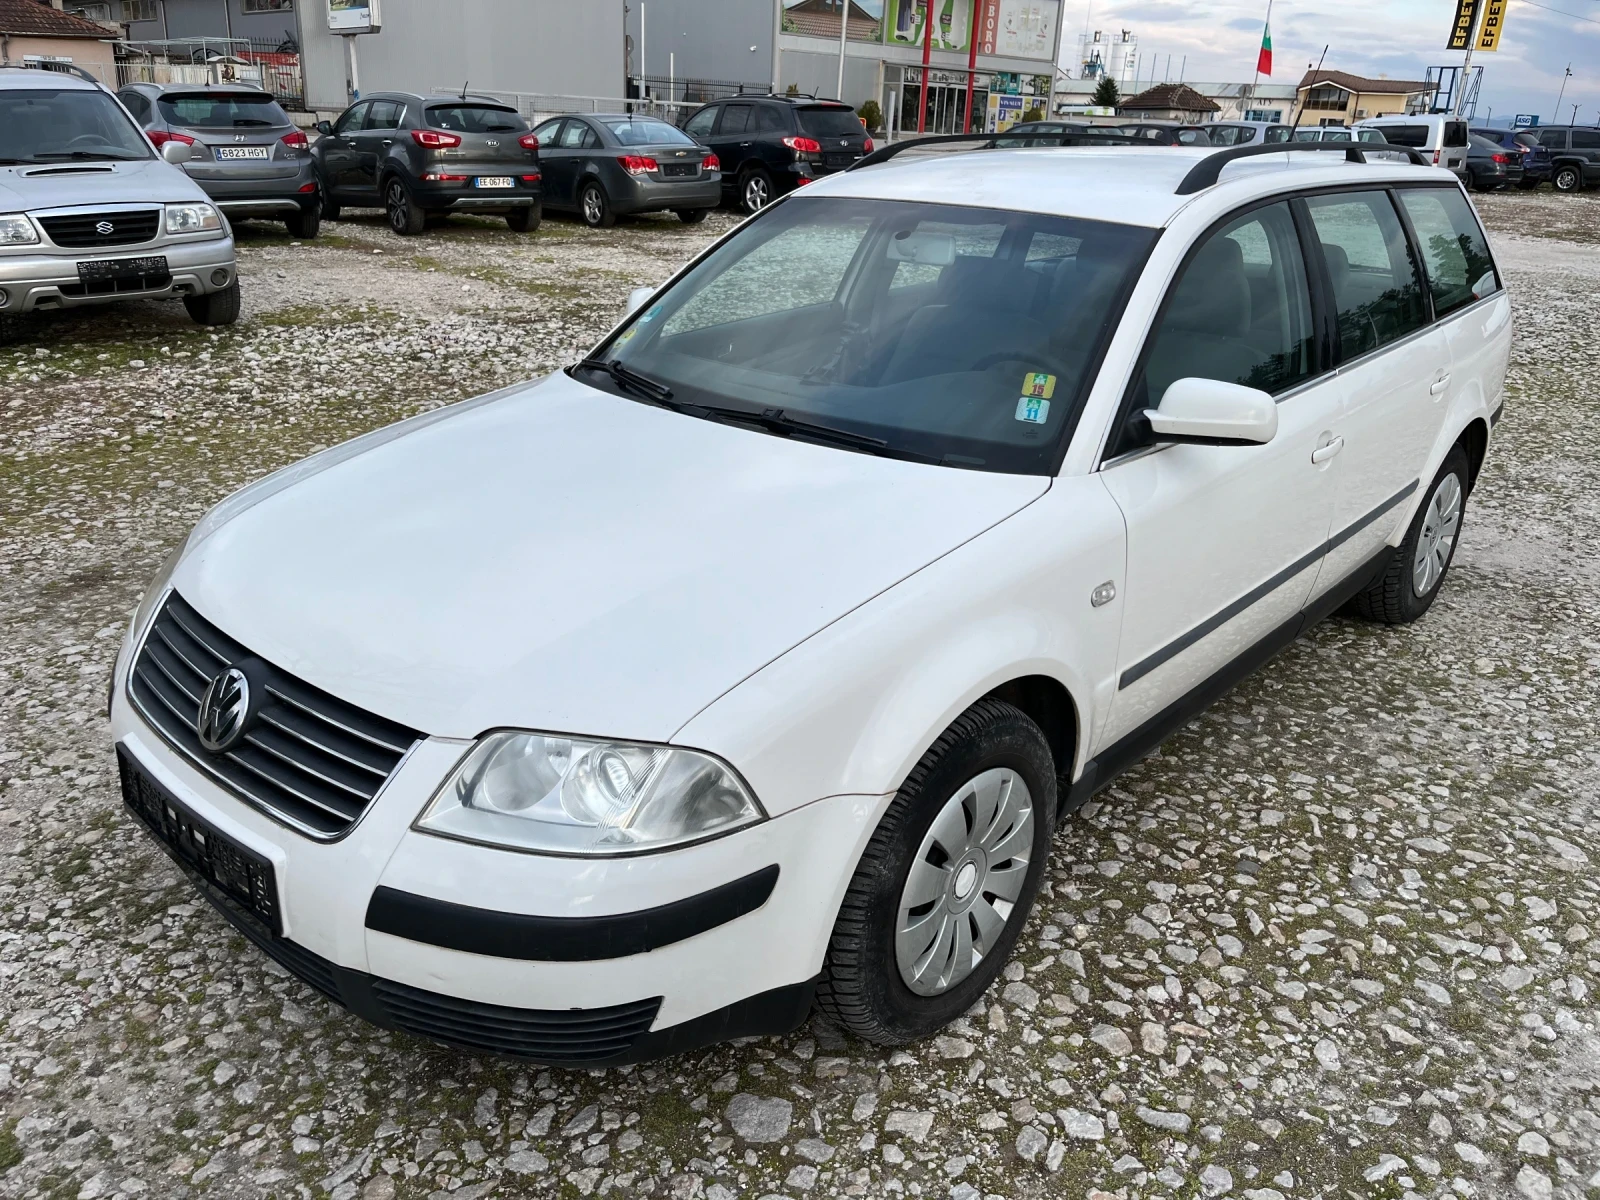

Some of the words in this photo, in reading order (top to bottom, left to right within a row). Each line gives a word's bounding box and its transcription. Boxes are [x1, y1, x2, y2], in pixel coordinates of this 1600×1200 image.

[222, 149, 246, 157] 6823
[247, 149, 265, 157] HGY
[1026, 408, 1039, 419] 11
